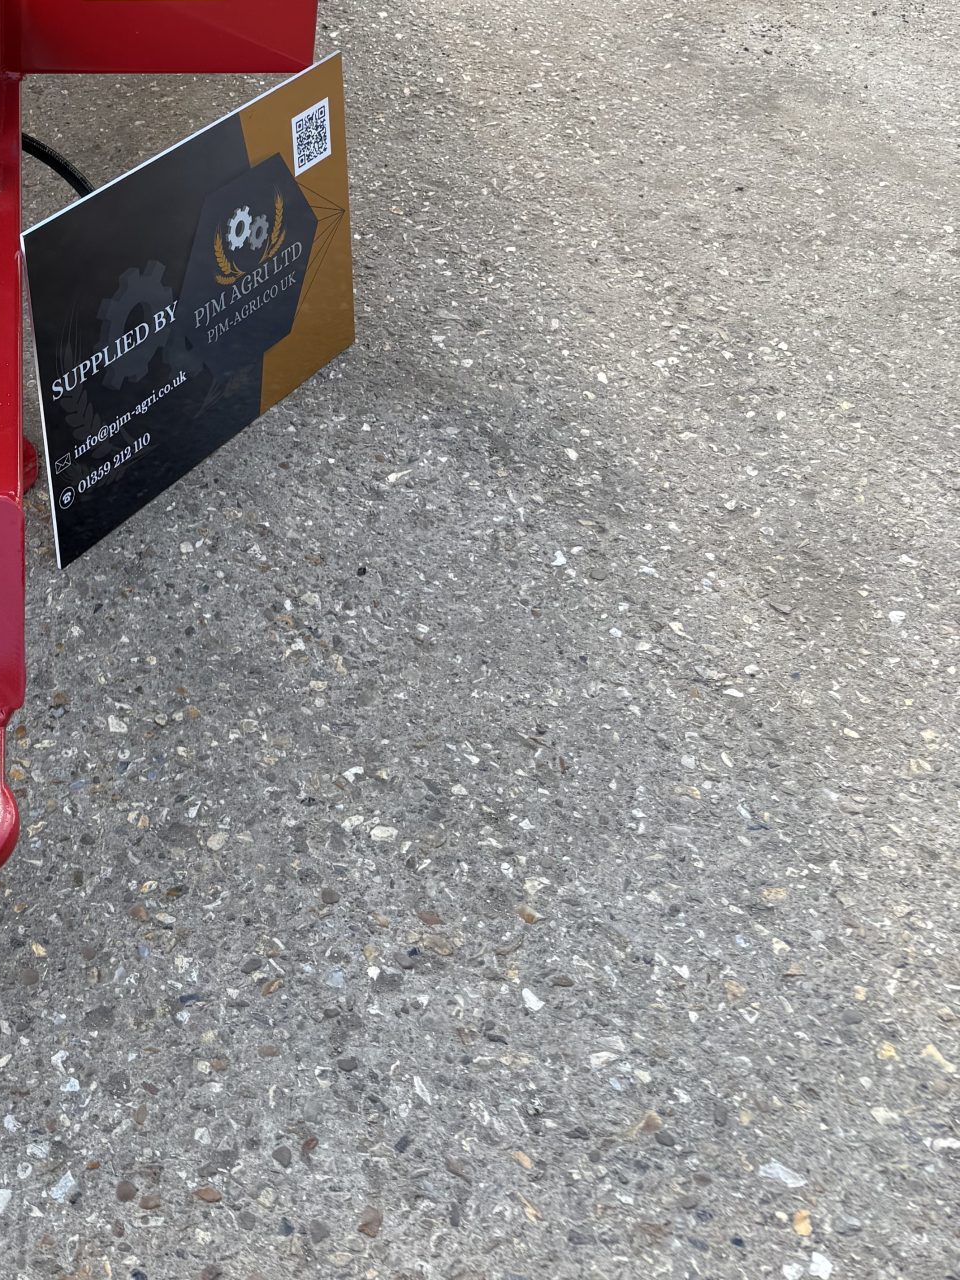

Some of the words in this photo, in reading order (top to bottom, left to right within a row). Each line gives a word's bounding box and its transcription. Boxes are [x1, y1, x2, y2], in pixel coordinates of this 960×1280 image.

[193, 290, 227, 329] PJM
[230, 261, 270, 305] AGRI
[273, 241, 303, 275] LTD
[51, 321, 150, 401] SUPPLIED
[153, 300, 178, 334] BY
[73, 370, 187, 460] info@pjm-agri.co.uk
[77, 461, 112, 494] 01359
[113, 446, 132, 469] 212
[133, 432, 151, 457] 110
